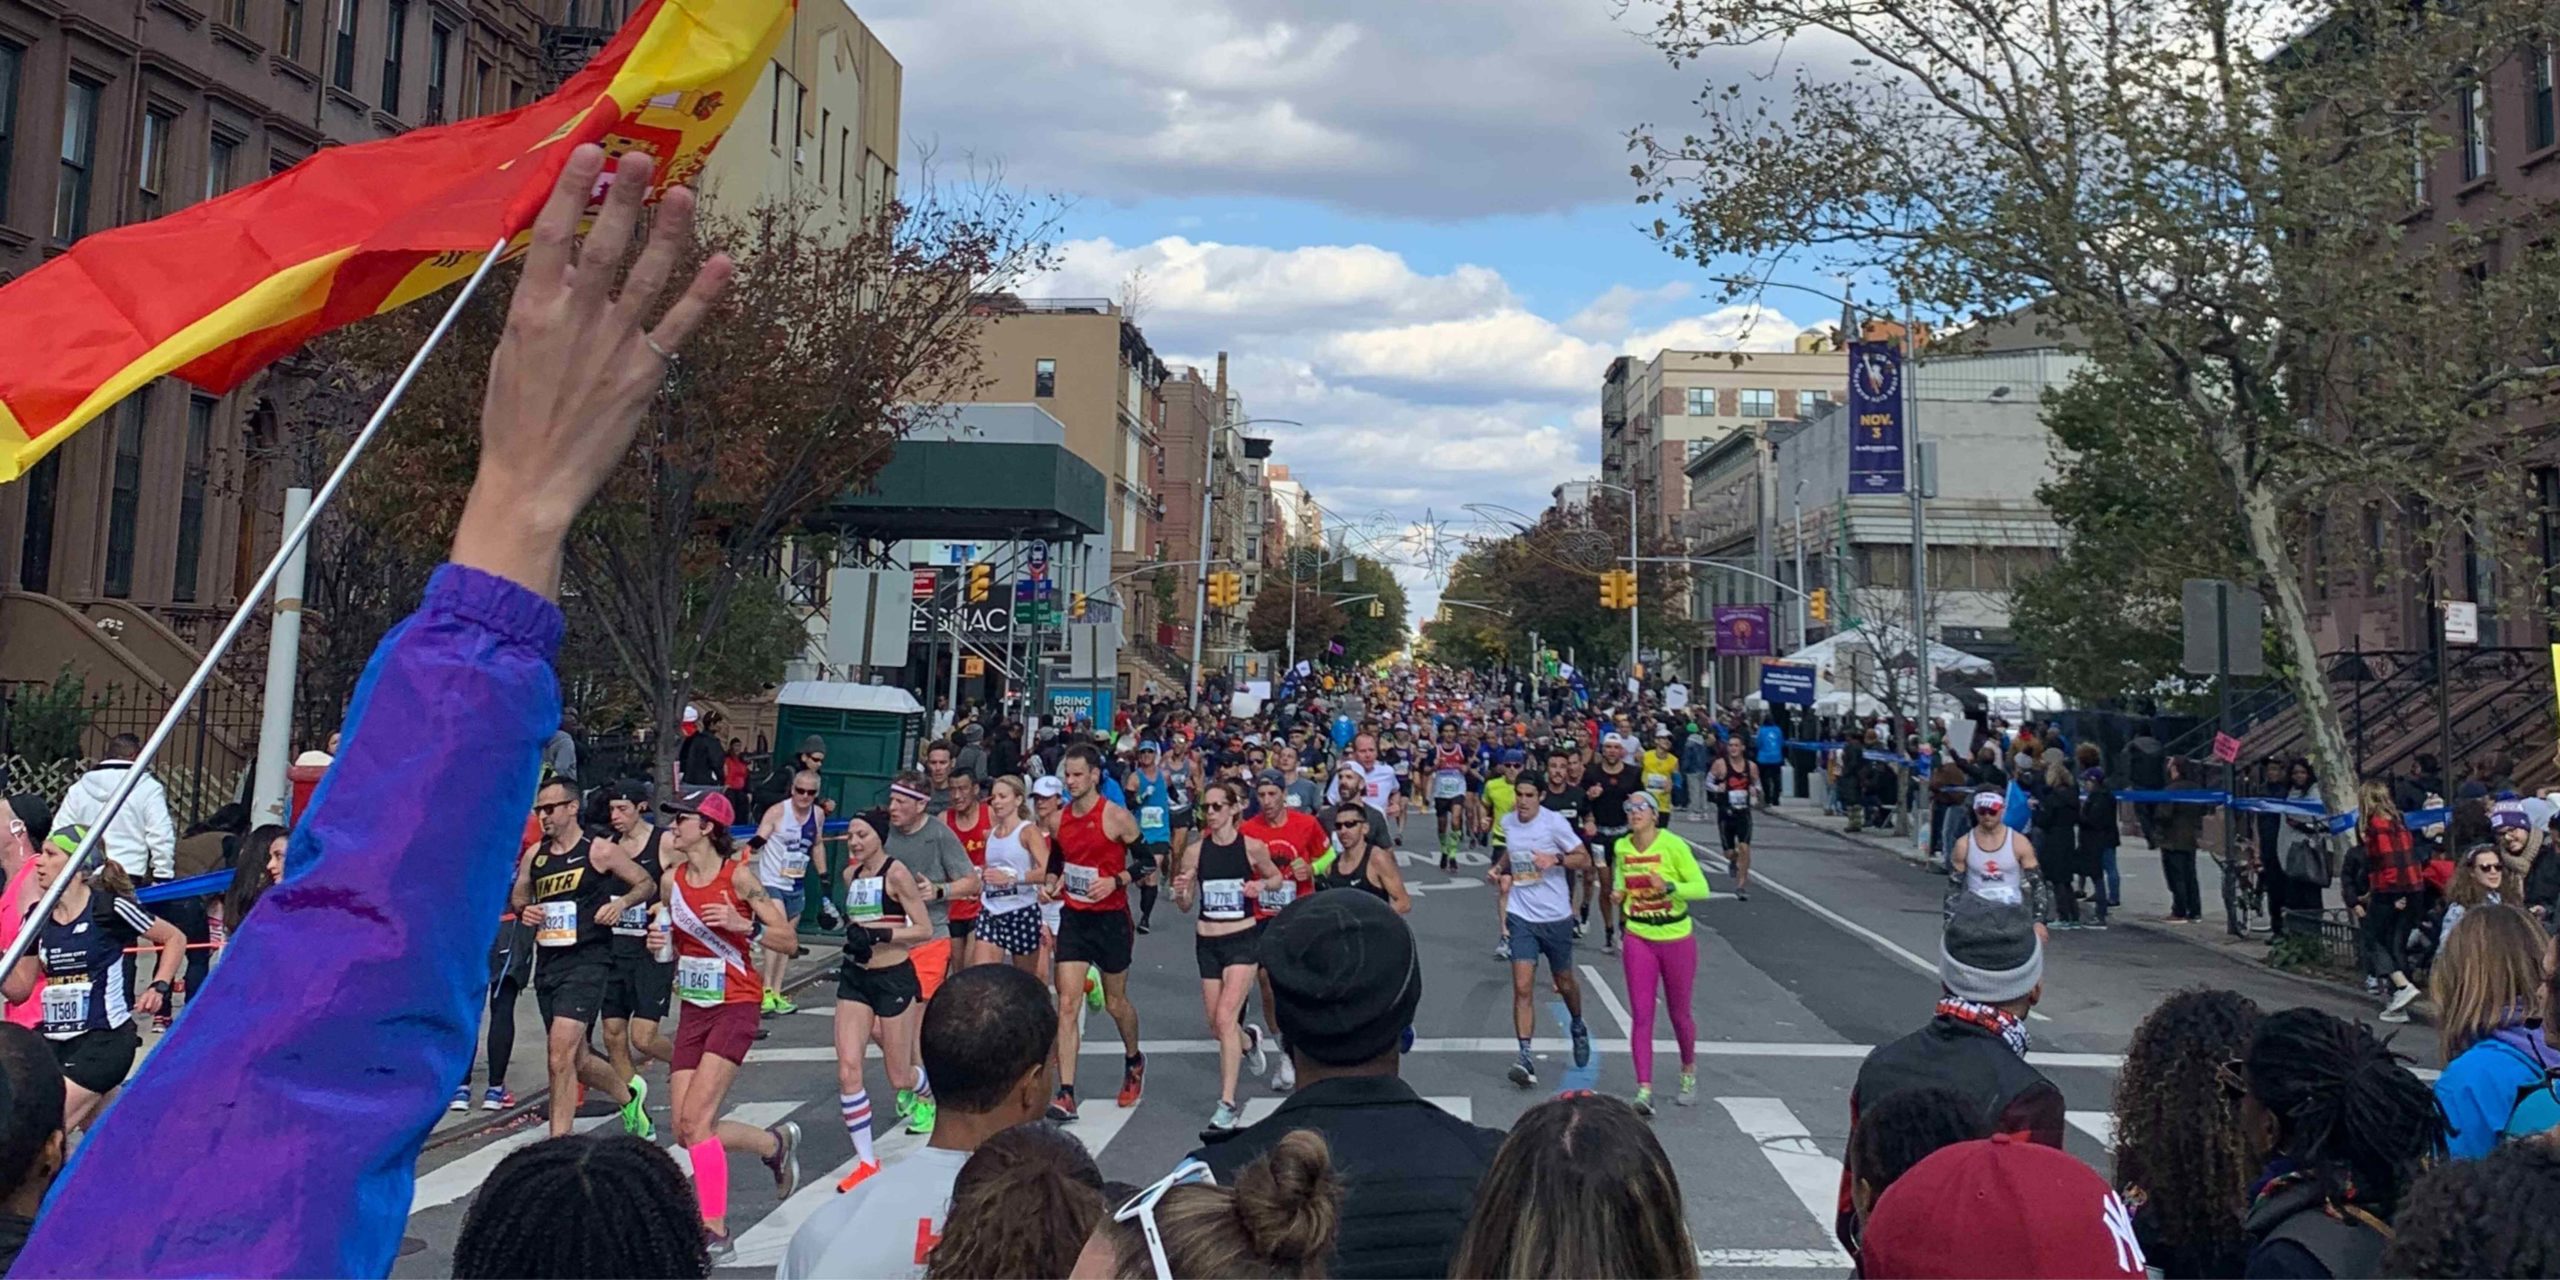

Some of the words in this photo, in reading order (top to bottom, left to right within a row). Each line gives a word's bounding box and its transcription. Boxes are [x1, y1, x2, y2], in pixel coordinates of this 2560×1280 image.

[1860, 413, 1894, 426] NOV.
[1872, 427, 1882, 438] 3
[1054, 696, 1091, 706] BRING
[1053, 707, 1087, 716] YOUR
[690, 973, 710, 989] 846
[51, 1001, 78, 1021] 7588
